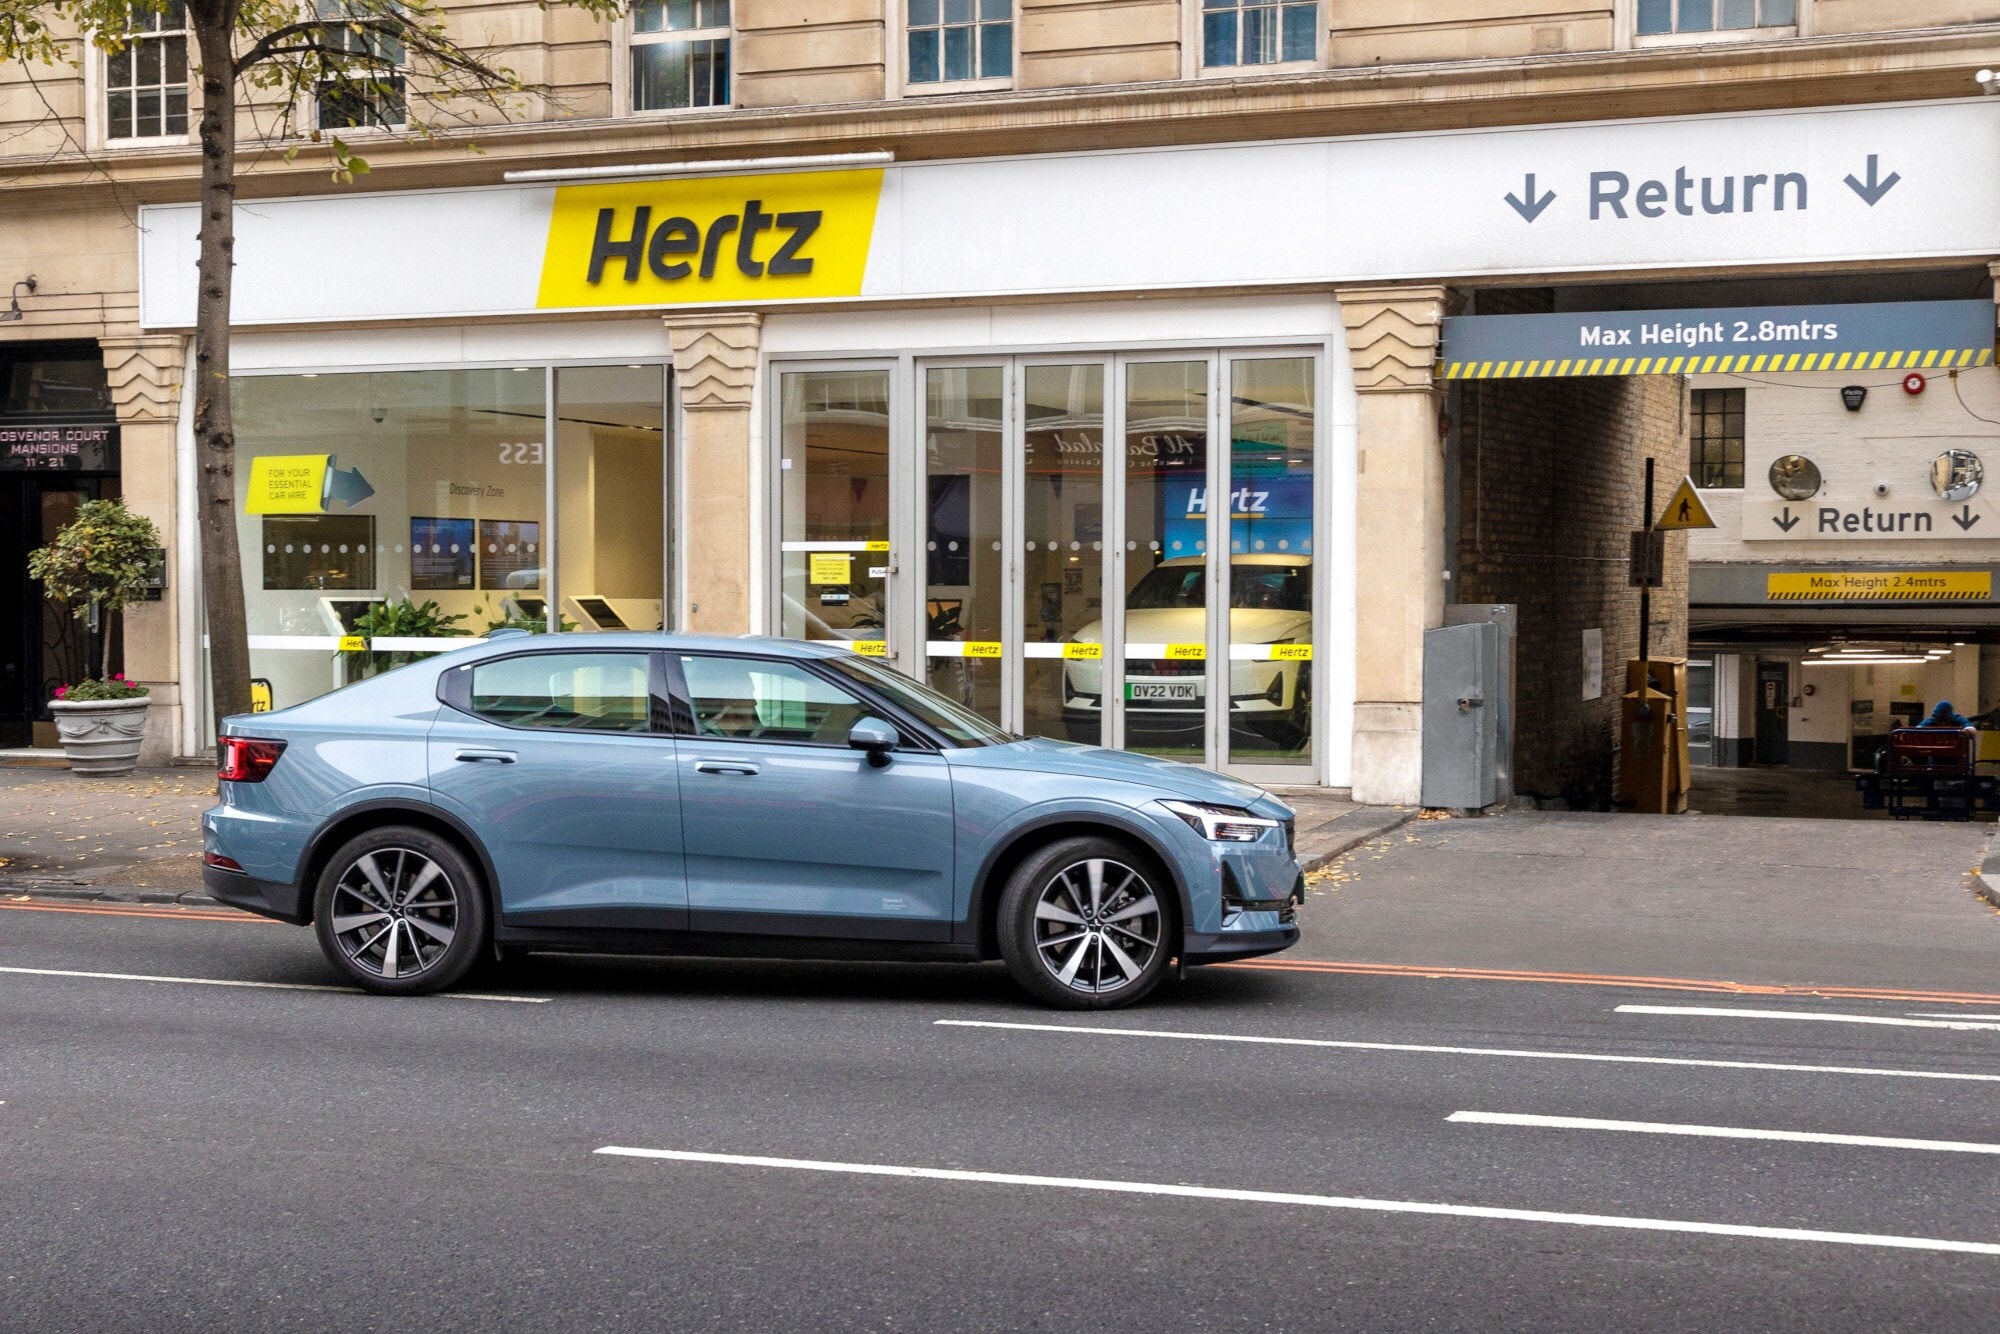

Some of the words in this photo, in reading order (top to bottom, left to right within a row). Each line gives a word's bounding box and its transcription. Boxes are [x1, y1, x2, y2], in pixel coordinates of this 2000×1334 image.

[1590, 165, 1808, 220] Return
[586, 200, 823, 283] Hertz
[1580, 326, 1632, 346] Max
[1641, 322, 1724, 348] Height
[1732, 320, 1838, 343] 2.8mtrs
[0, 431, 60, 441] OSVENOR
[66, 430, 109, 441] COURT
[11, 443, 78, 454] MANSIONS
[26, 458, 36, 467] 11
[48, 457, 64, 467] 21
[268, 469, 285, 478] FOR
[288, 468, 310, 477] YOUR
[268, 479, 312, 489] ESSENTIAL
[268, 491, 285, 500] CAR
[288, 490, 307, 499] HIRE
[449, 483, 484, 499] Discovery
[486, 485, 504, 497] Zone
[1187, 487, 1268, 512] Hrtz
[1818, 507, 1932, 533] Return
[1810, 577, 1839, 587] Max
[1844, 576, 1888, 589] Height
[1893, 576, 1947, 587] 2.4mtrs
[346, 639, 363, 648] Her
[860, 643, 886, 653] Hertz
[972, 644, 998, 654] Hertz
[1071, 646, 1099, 656] Hertz
[1174, 646, 1202, 656] Hertz
[1279, 647, 1309, 657] Hertz
[1134, 685, 1166, 698] OV22
[1169, 686, 1193, 698] VDK
[252, 700, 266, 712] rtz
